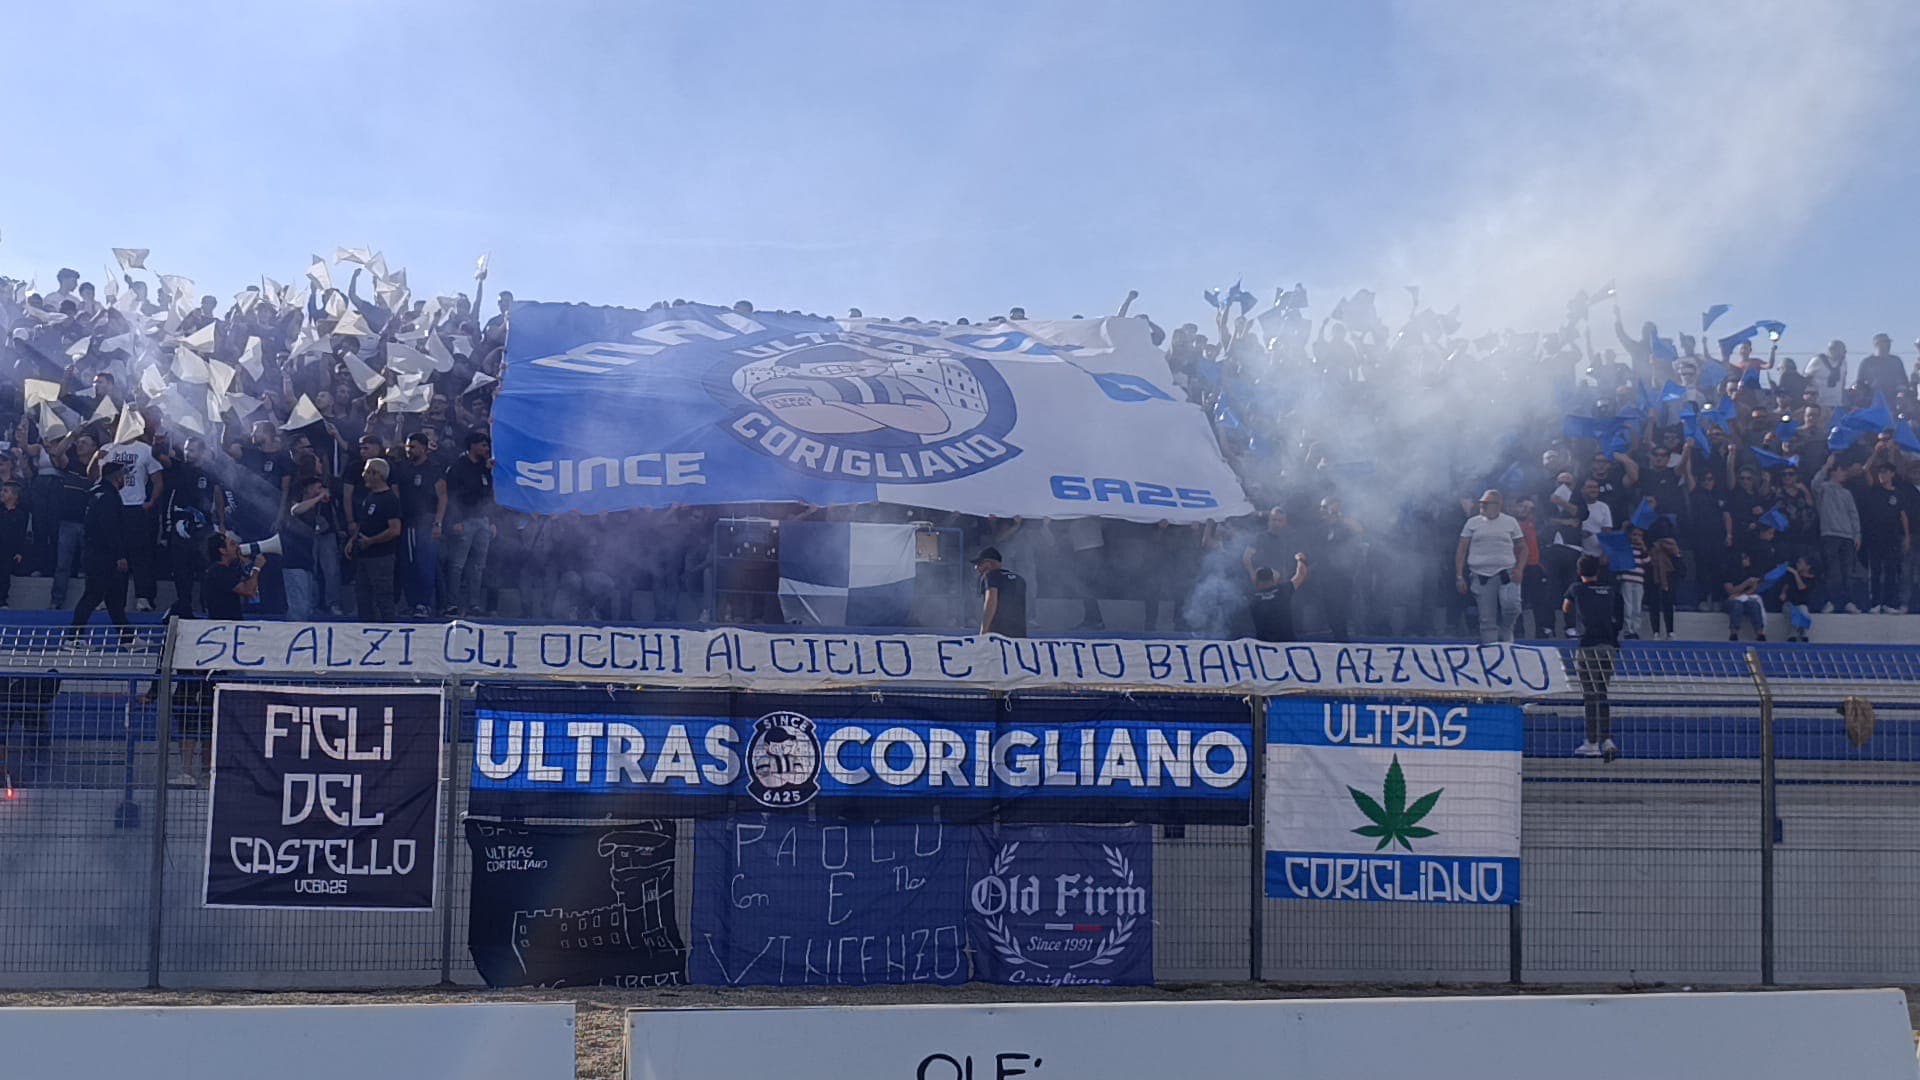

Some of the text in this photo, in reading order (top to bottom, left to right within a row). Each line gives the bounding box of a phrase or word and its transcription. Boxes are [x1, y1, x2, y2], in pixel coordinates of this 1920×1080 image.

[530, 312, 767, 374] MAI
[731, 412, 1007, 478] CORIGLIANO
[515, 452, 706, 494] SINCE
[1050, 475, 1220, 510] 6A25
[196, 624, 264, 666] SE
[286, 626, 415, 666] ALZI
[444, 624, 518, 669] GLI
[540, 632, 683, 673] OCCHI
[706, 632, 756, 672] AL
[770, 638, 912, 677] CIELO
[937, 637, 975, 678] E'
[989, 637, 1125, 679] TUTTO
[1336, 644, 1550, 691] AZZURRO
[763, 715, 810, 731] SINCE
[1323, 703, 1468, 747] ULTRAS
[476, 718, 1248, 788] ULTRAS CORIGLIANO
[282, 773, 384, 826] DEL
[763, 790, 801, 803] 6A25
[230, 837, 417, 876] CASTELLO
[484, 846, 533, 859] ULTRAS
[828, 872, 855, 925] E
[971, 873, 1147, 917] Old Firm
[1027, 936, 1093, 951] Since 1991
